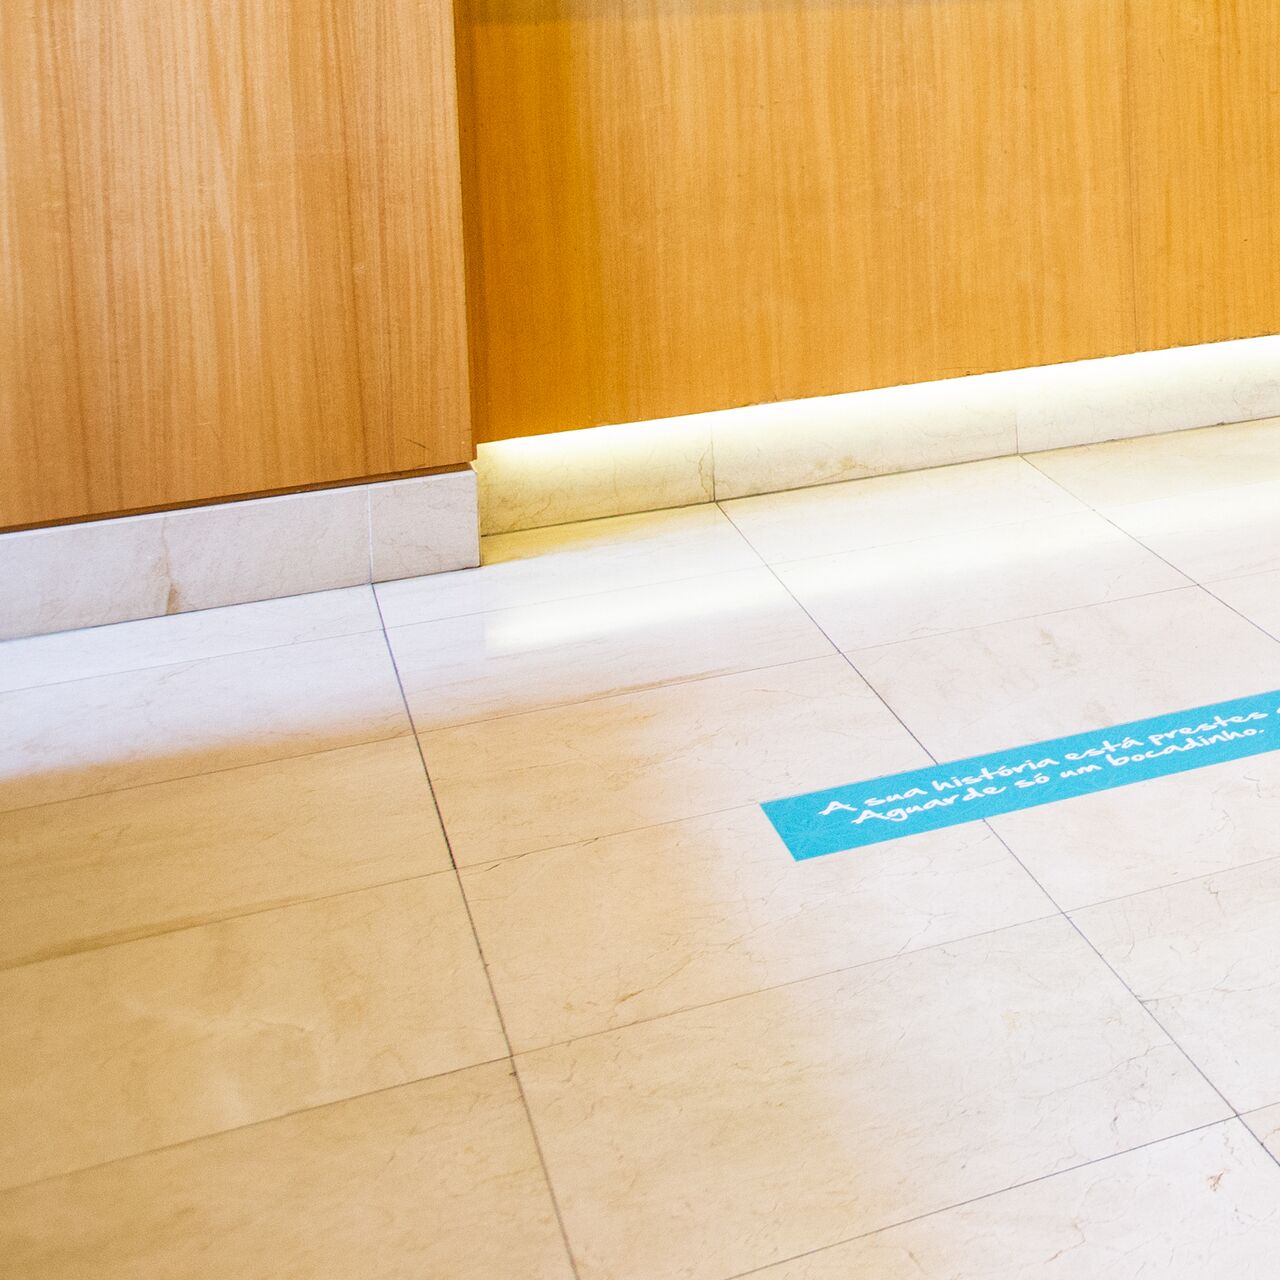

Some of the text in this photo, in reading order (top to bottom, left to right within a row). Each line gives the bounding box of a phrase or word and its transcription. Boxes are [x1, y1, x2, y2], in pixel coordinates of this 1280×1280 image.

[819, 799, 857, 816] A
[864, 787, 928, 807] sua
[931, 758, 1059, 792] história
[1064, 735, 1144, 762] está
[1148, 710, 1268, 747] prestes
[851, 725, 1265, 824] Aguarde só um bocadinho.
